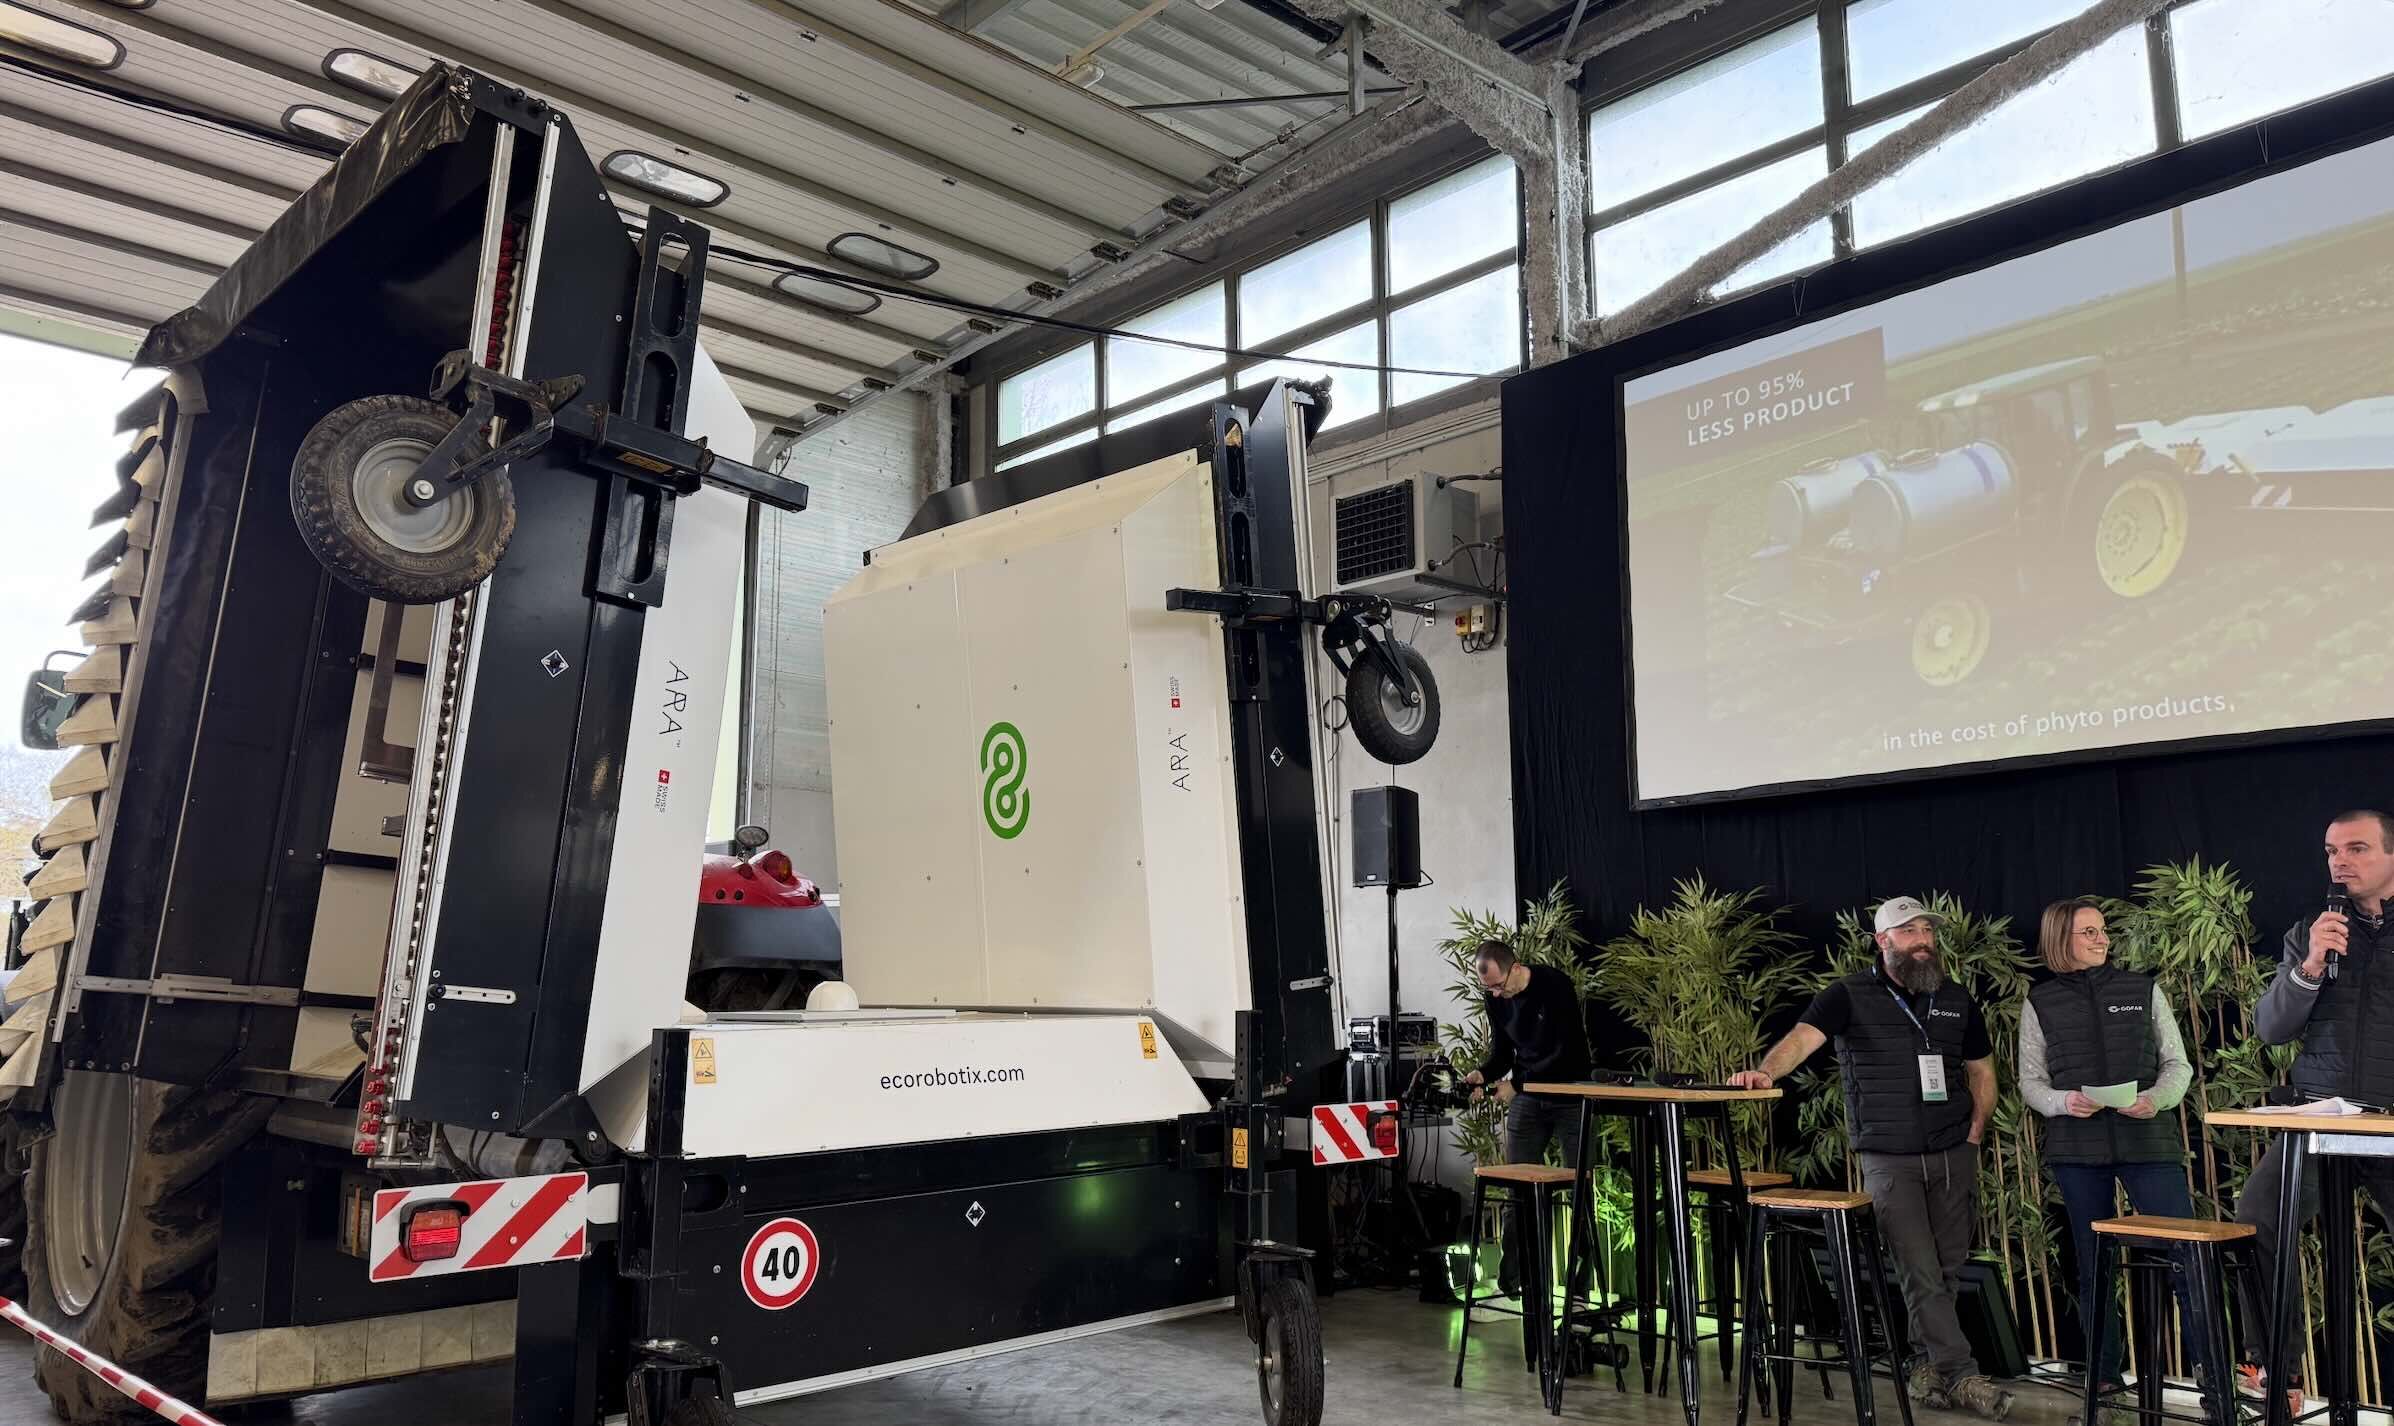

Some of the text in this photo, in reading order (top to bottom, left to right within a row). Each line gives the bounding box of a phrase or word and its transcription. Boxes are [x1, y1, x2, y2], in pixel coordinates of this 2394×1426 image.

[1687, 369, 1804, 421] UP TO 95%
[1688, 382, 1855, 447] LESS PRODUCT
[1883, 696, 2235, 751] in the cost of phyto products,
[880, 1066, 1025, 1089] ecorobotix.com
[762, 1246, 800, 1281] 40
